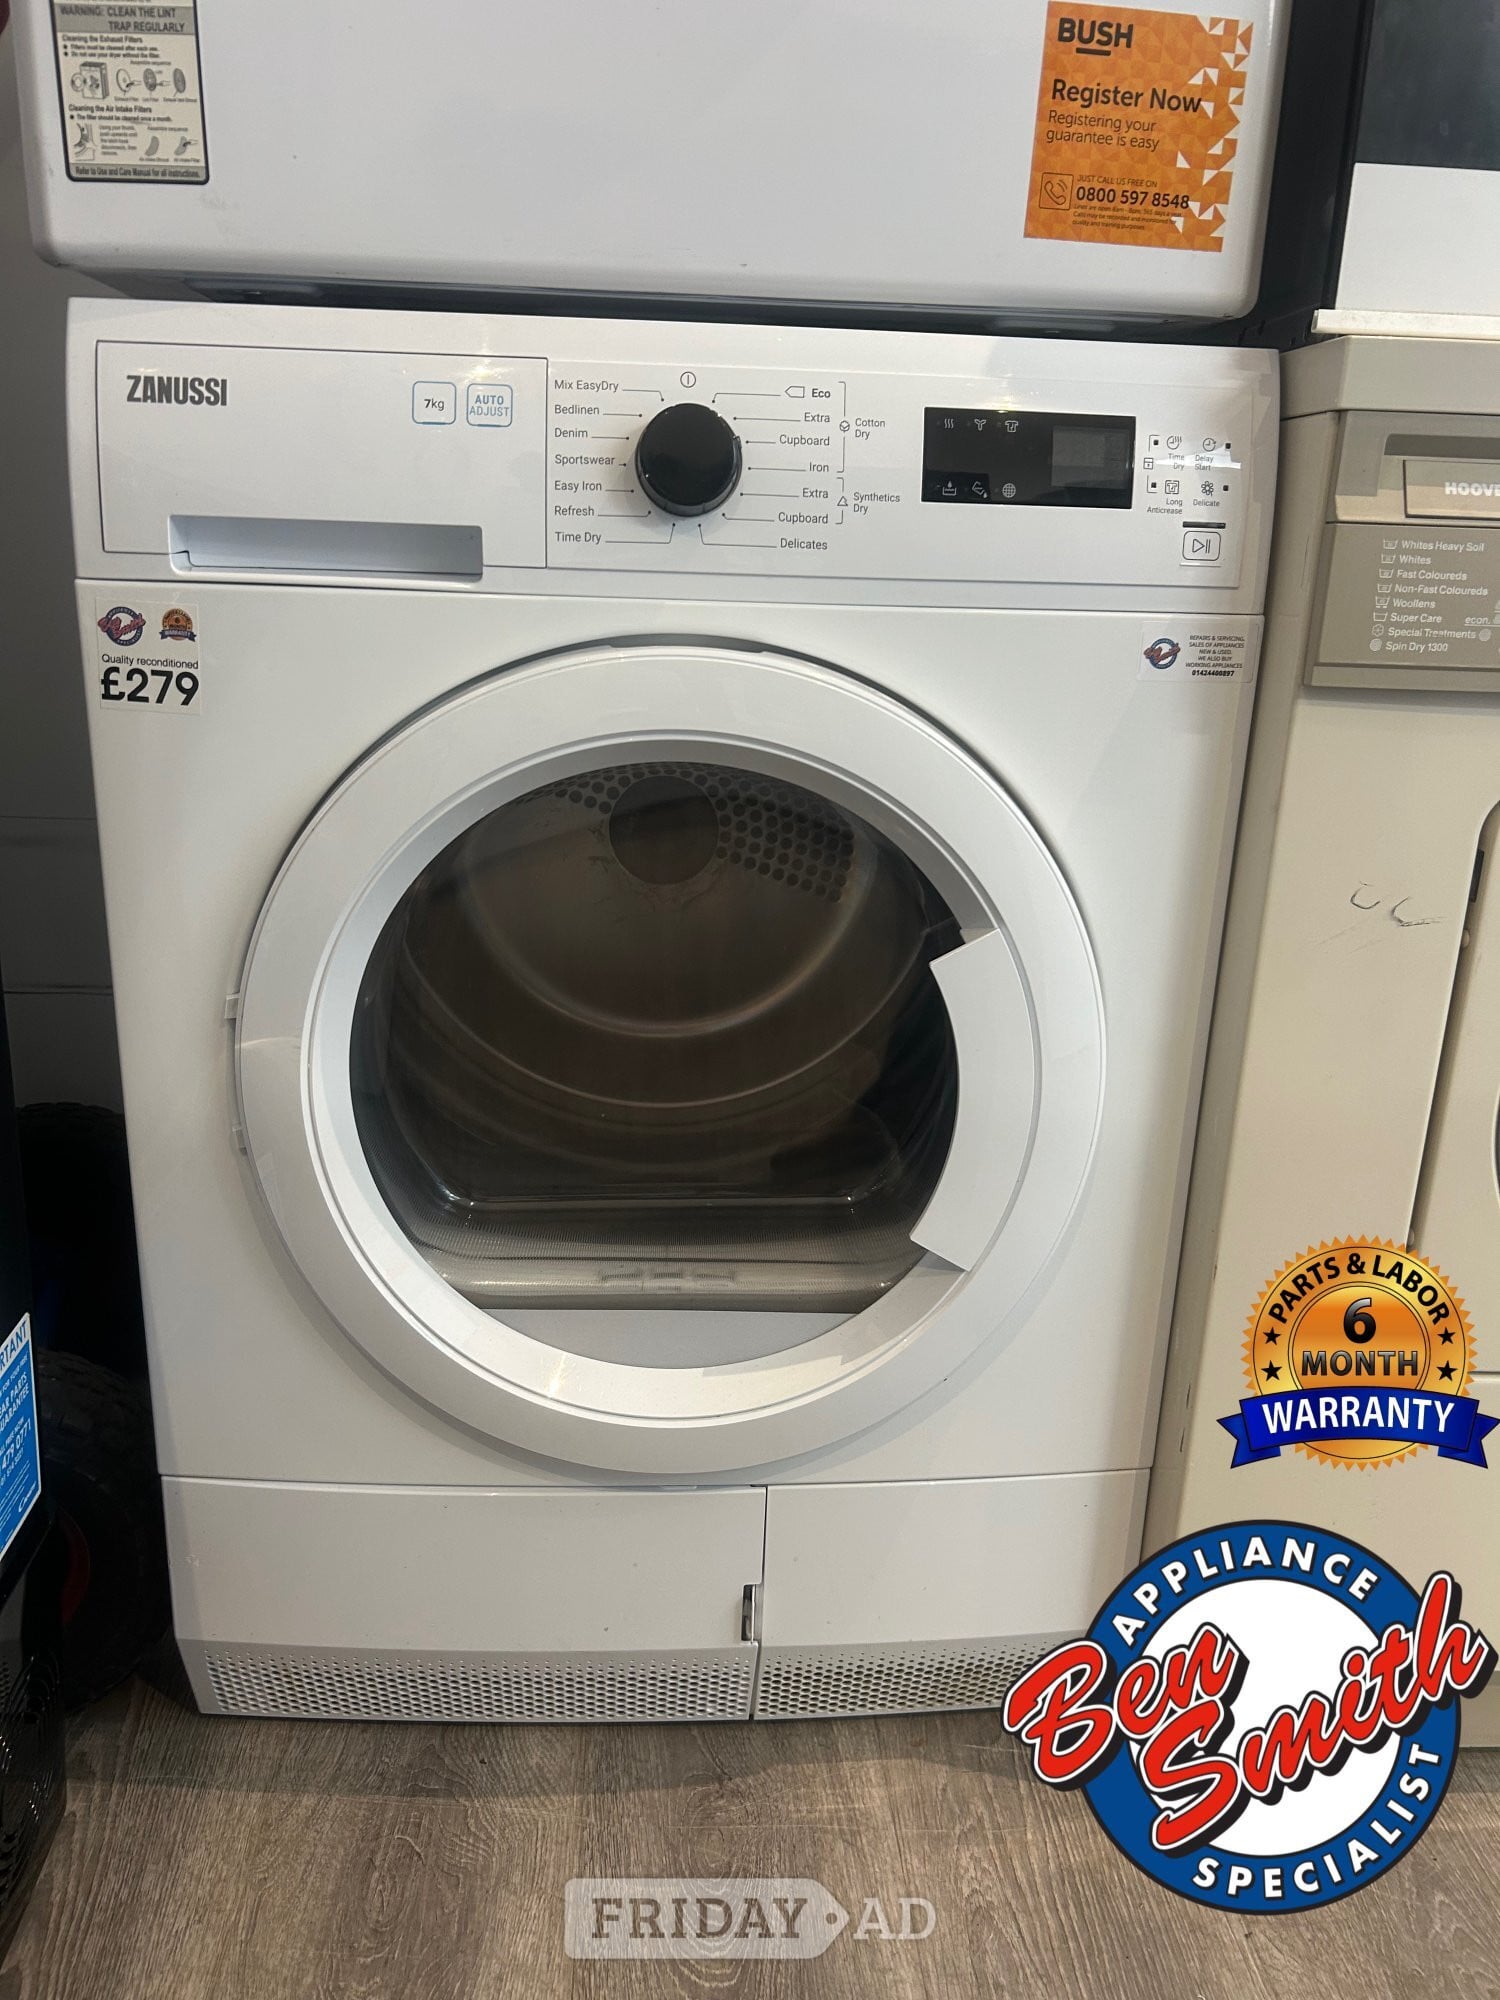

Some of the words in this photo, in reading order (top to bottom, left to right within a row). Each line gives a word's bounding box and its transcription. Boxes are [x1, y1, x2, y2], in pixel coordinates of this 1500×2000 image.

[107, 7, 137, 17] CLEAN
[139, 8, 156, 18] THE
[157, 8, 176, 18] LINT
[108, 21, 131, 31] TRAP
[134, 22, 185, 32] REGULARLY
[1057, 17, 1134, 49] BUSH
[1051, 78, 1144, 108] Register
[1150, 88, 1202, 113] Now
[1048, 110, 1122, 132] Registering
[1125, 118, 1156, 133] your
[1046, 130, 1113, 146] guarantee
[1117, 134, 1127, 146] is
[1130, 137, 1160, 152] easy
[1097, 176, 1114, 184] CALL
[1127, 178, 1143, 186] FREE
[1076, 186, 1116, 203] 0800
[1120, 190, 1149, 205] 597
[1151, 193, 1190, 209] 8548
[126, 374, 228, 407] ZANUSSI
[554, 379, 574, 391] Mix
[576, 380, 619, 393] EasyDry
[811, 388, 831, 399] Eco
[424, 399, 445, 411] 7kg
[475, 395, 504, 405] AUTO
[469, 406, 510, 416] ADJUST
[554, 404, 600, 416] Bedlinen
[804, 413, 830, 423] Extra
[855, 418, 886, 428] Cotton
[554, 428, 588, 439] Denim
[854, 429, 870, 440] Dry
[779, 435, 830, 448] Cupboard
[554, 454, 615, 467] Sportswear
[1195, 454, 1213, 462] Delay
[809, 462, 829, 473] Iron
[554, 481, 580, 492] Easy
[582, 481, 602, 492] Iron
[802, 488, 829, 499] Extra
[853, 493, 900, 504] Synthetics
[1166, 498, 1183, 506] Long
[554, 506, 595, 516] Refresh
[853, 503, 869, 514] Dry
[778, 512, 829, 525] Cupboard
[555, 532, 581, 543] Time
[582, 533, 602, 545] Dry
[780, 538, 828, 550] Delicates
[1401, 541, 1434, 550] Whites
[1435, 541, 1465, 553] Heavy
[1466, 542, 1484, 552] Soil
[1399, 555, 1431, 565] Whites
[1396, 570, 1417, 579] Fast
[1418, 570, 1467, 581] Coloureds
[1395, 584, 1438, 594] Non-Fast
[1439, 585, 1488, 596] Coloureds
[1393, 598, 1436, 609] Woollens
[1390, 613, 1419, 624] Super
[1420, 614, 1442, 623] Care
[1465, 616, 1491, 625] econ.
[1388, 627, 1422, 637] Special
[1424, 628, 1476, 639] Treatments
[1385, 641, 1407, 653] Spin
[1409, 642, 1426, 653] Dry
[1428, 642, 1448, 652] 1300
[102, 654, 134, 666] Quality
[137, 658, 198, 669] reconditioned
[101, 666, 199, 706] £279
